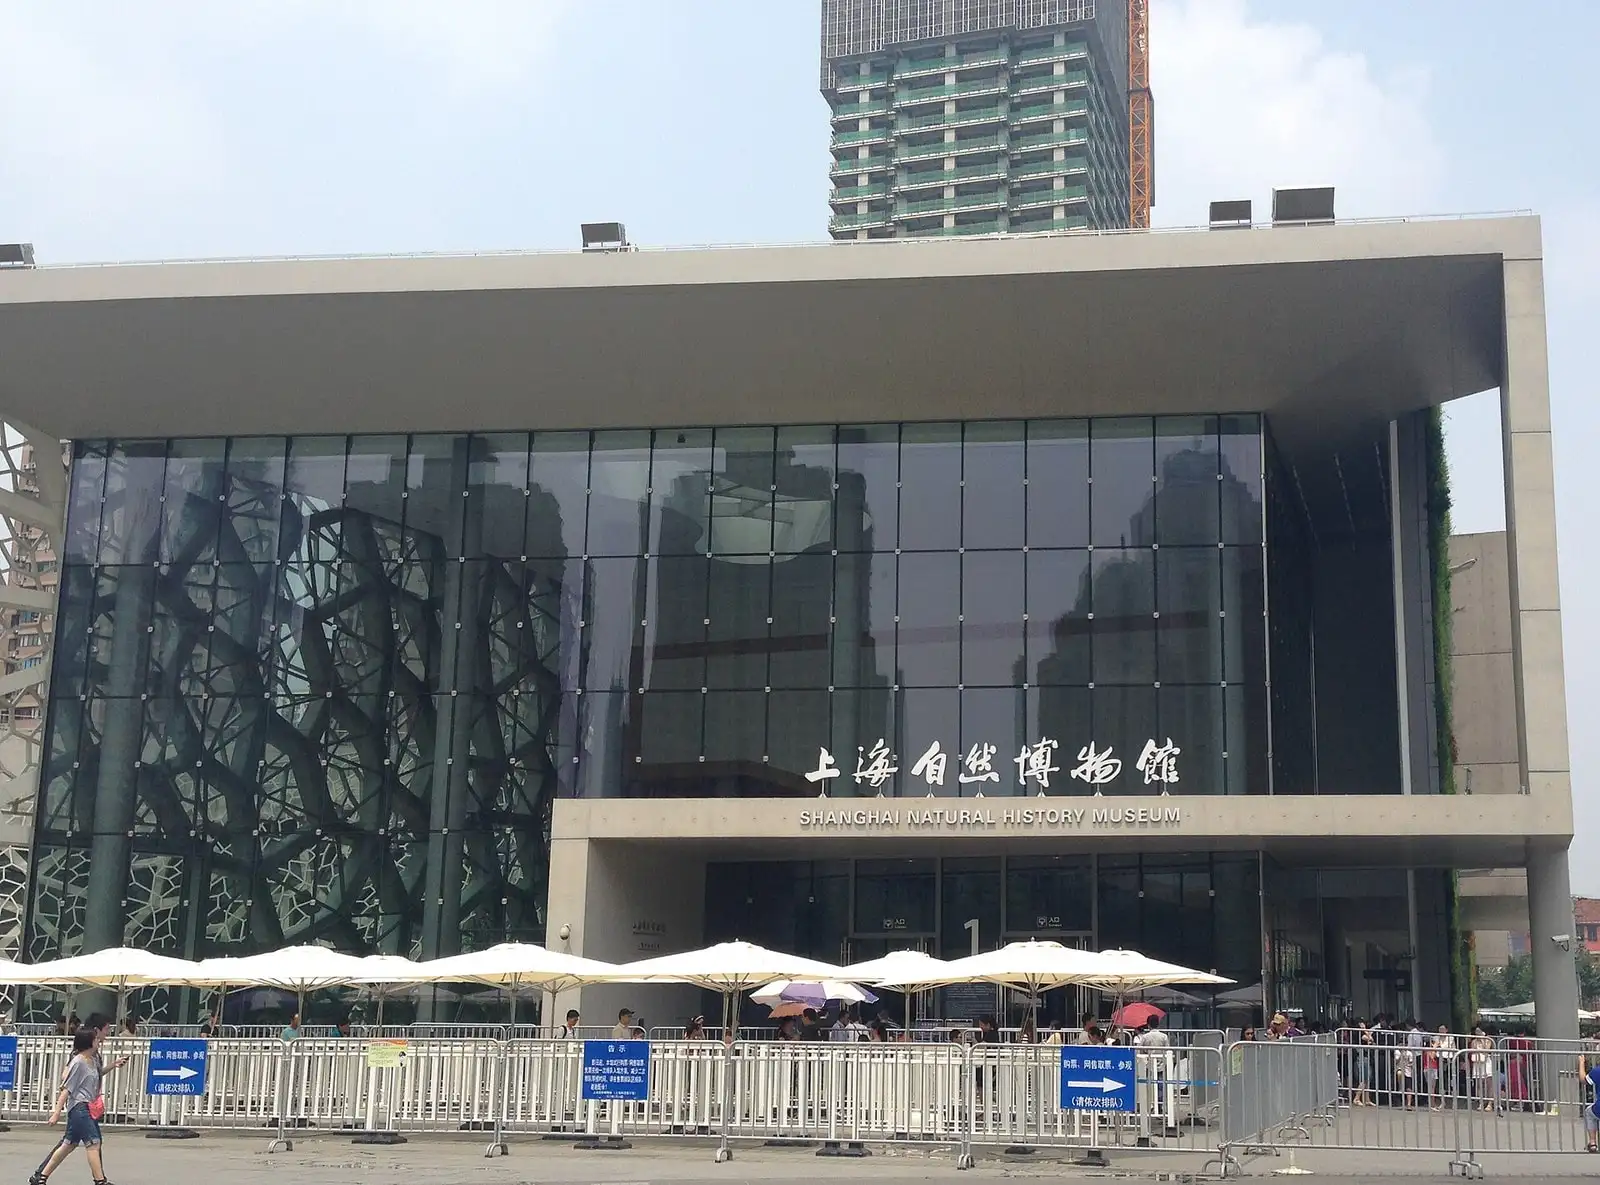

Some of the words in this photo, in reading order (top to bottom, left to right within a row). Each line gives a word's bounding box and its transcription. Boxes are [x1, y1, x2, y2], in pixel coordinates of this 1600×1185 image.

[800, 810, 900, 826] SHANGHAI
[907, 809, 996, 825] NATURAL
[1003, 808, 1085, 824] HISTORY
[1092, 807, 1181, 823] MUSEUM
[963, 918, 980, 956] 1
